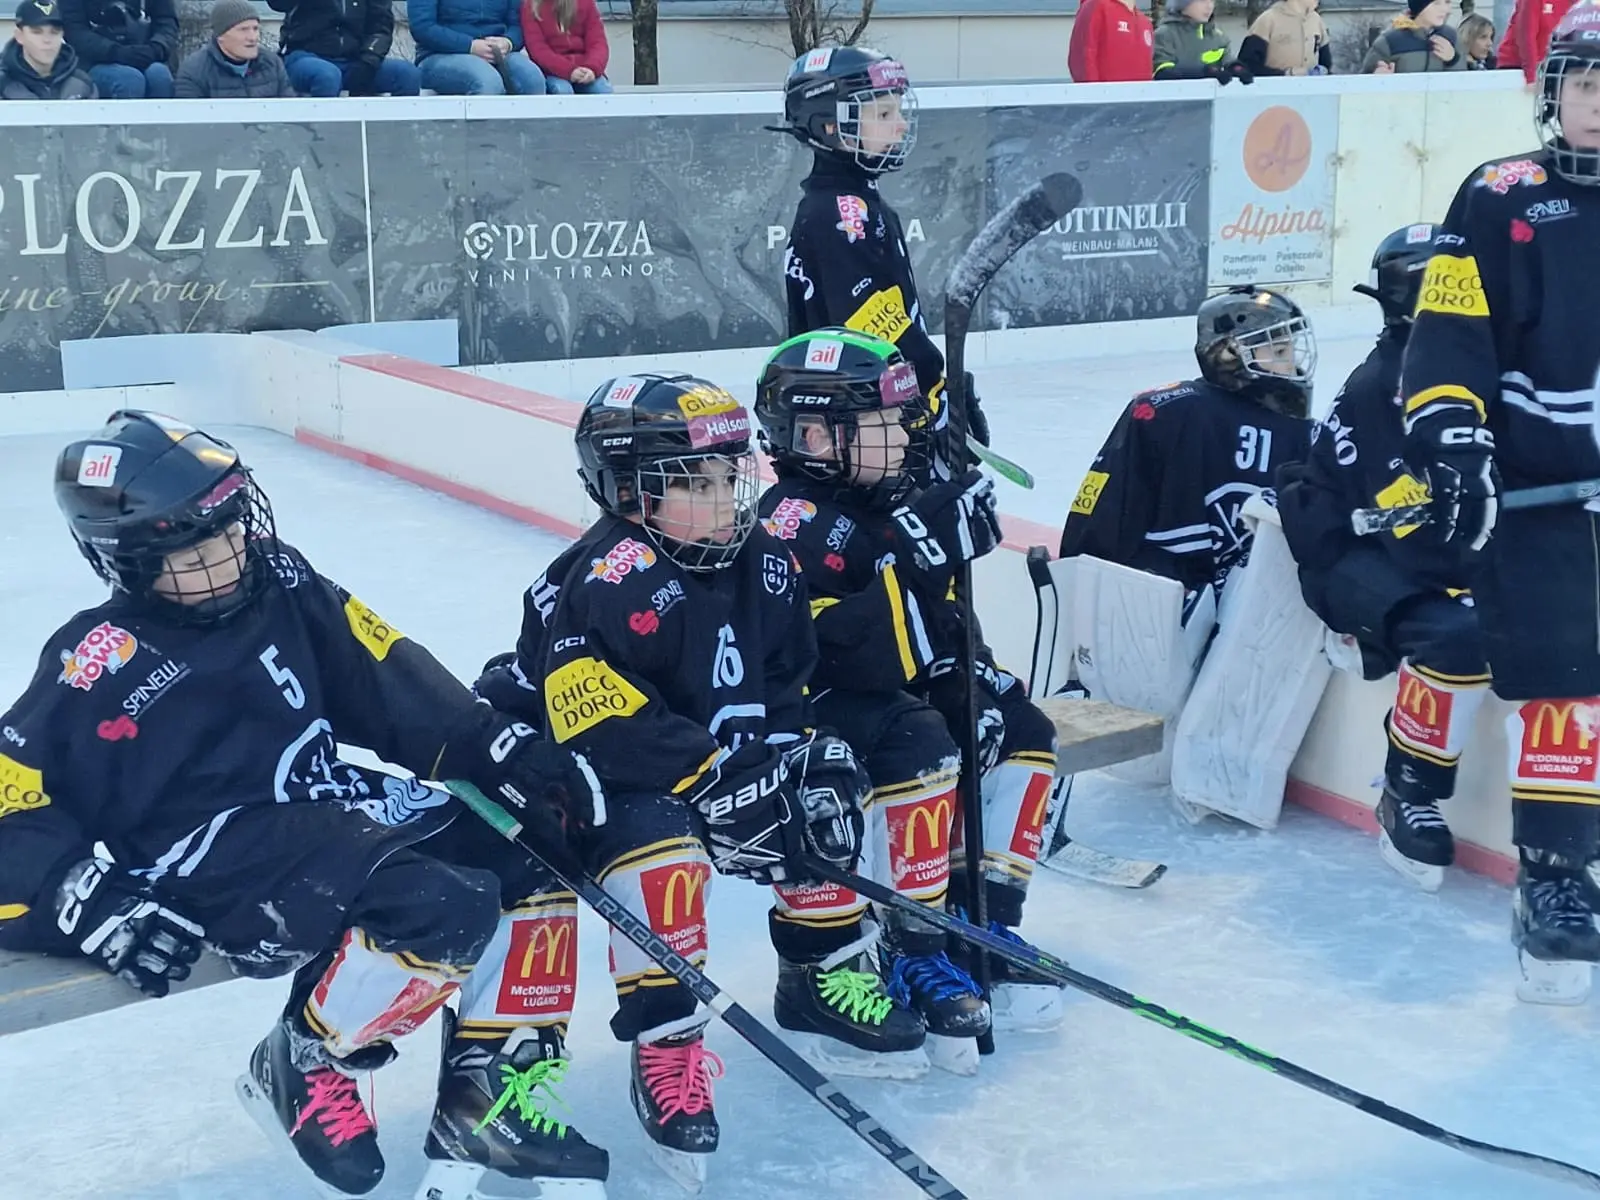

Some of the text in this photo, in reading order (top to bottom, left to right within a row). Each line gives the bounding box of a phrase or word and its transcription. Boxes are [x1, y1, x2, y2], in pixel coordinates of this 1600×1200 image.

[0, 167, 328, 256] LOZZA
[1040, 202, 1188, 236] OTTINELLI
[1221, 203, 1325, 244] Alpina
[504, 219, 655, 261] PLOZZA
[468, 262, 654, 288] VINI TIRANO
[1424, 288, 1476, 309] ORO
[811, 345, 836, 364] ail
[610, 383, 637, 401] ail
[791, 394, 832, 405] CCM
[602, 436, 633, 447] CCM
[1235, 424, 1273, 473] 31
[84, 454, 113, 479] ail
[78, 623, 119, 658] FOX
[74, 632, 130, 690] TOWN
[122, 659, 180, 716] SPINELLI
[259, 644, 306, 710] 5
[563, 693, 628, 730] D'ORO
[1525, 753, 1594, 766] McDONALD'S
[1532, 764, 1580, 775] LUGANO
[511, 984, 573, 997] McDONALD'S
[523, 996, 560, 1008] LUGANO
[815, 1081, 957, 1199] CCM
